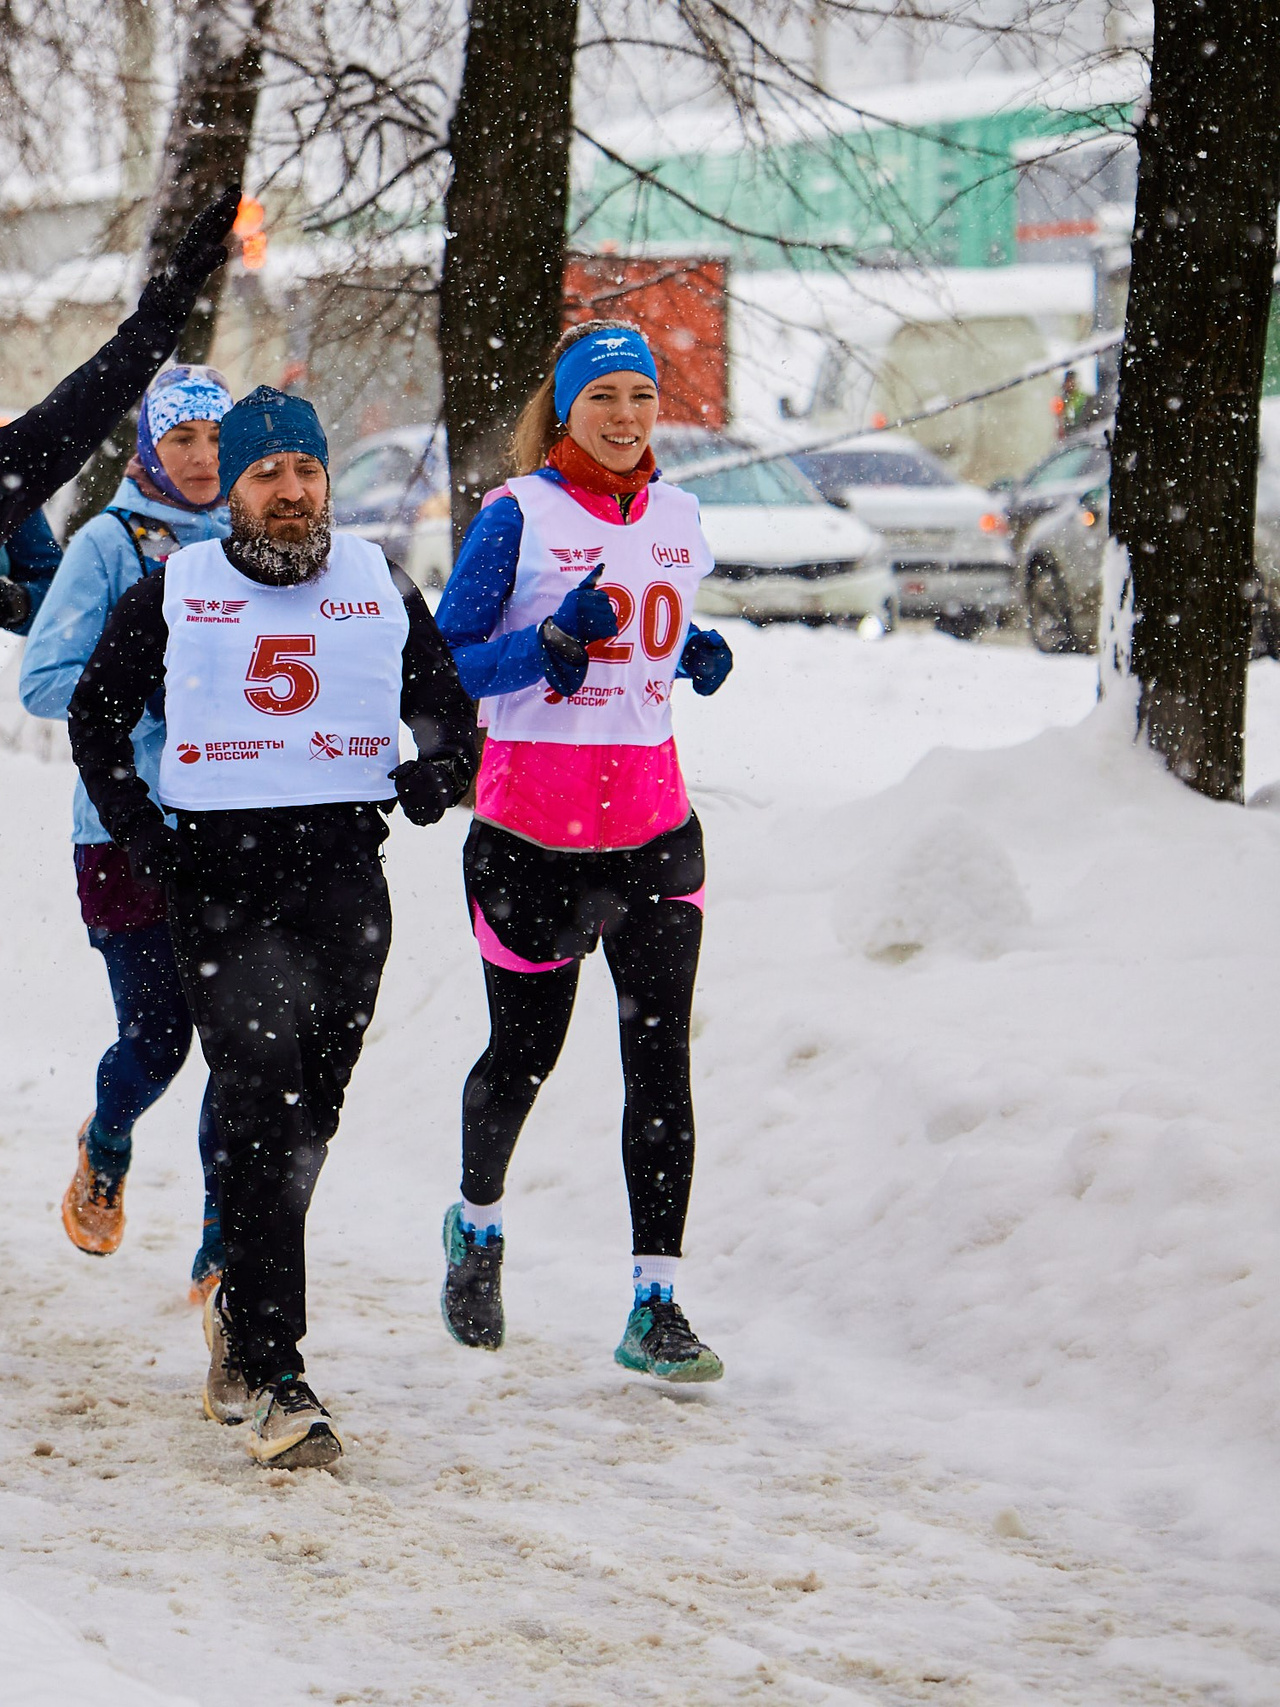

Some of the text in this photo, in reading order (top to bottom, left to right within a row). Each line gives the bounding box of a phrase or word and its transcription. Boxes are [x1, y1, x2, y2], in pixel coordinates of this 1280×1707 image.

[585, 581, 683, 664] 20
[243, 634, 320, 716] 5
[567, 695, 608, 706] РОССИИ
[205, 740, 284, 751] ВЕРТОЛЕТЫ
[349, 737, 391, 746] ППОО
[206, 751, 259, 761] РОССИИ
[348, 746, 379, 758] НЦВ
